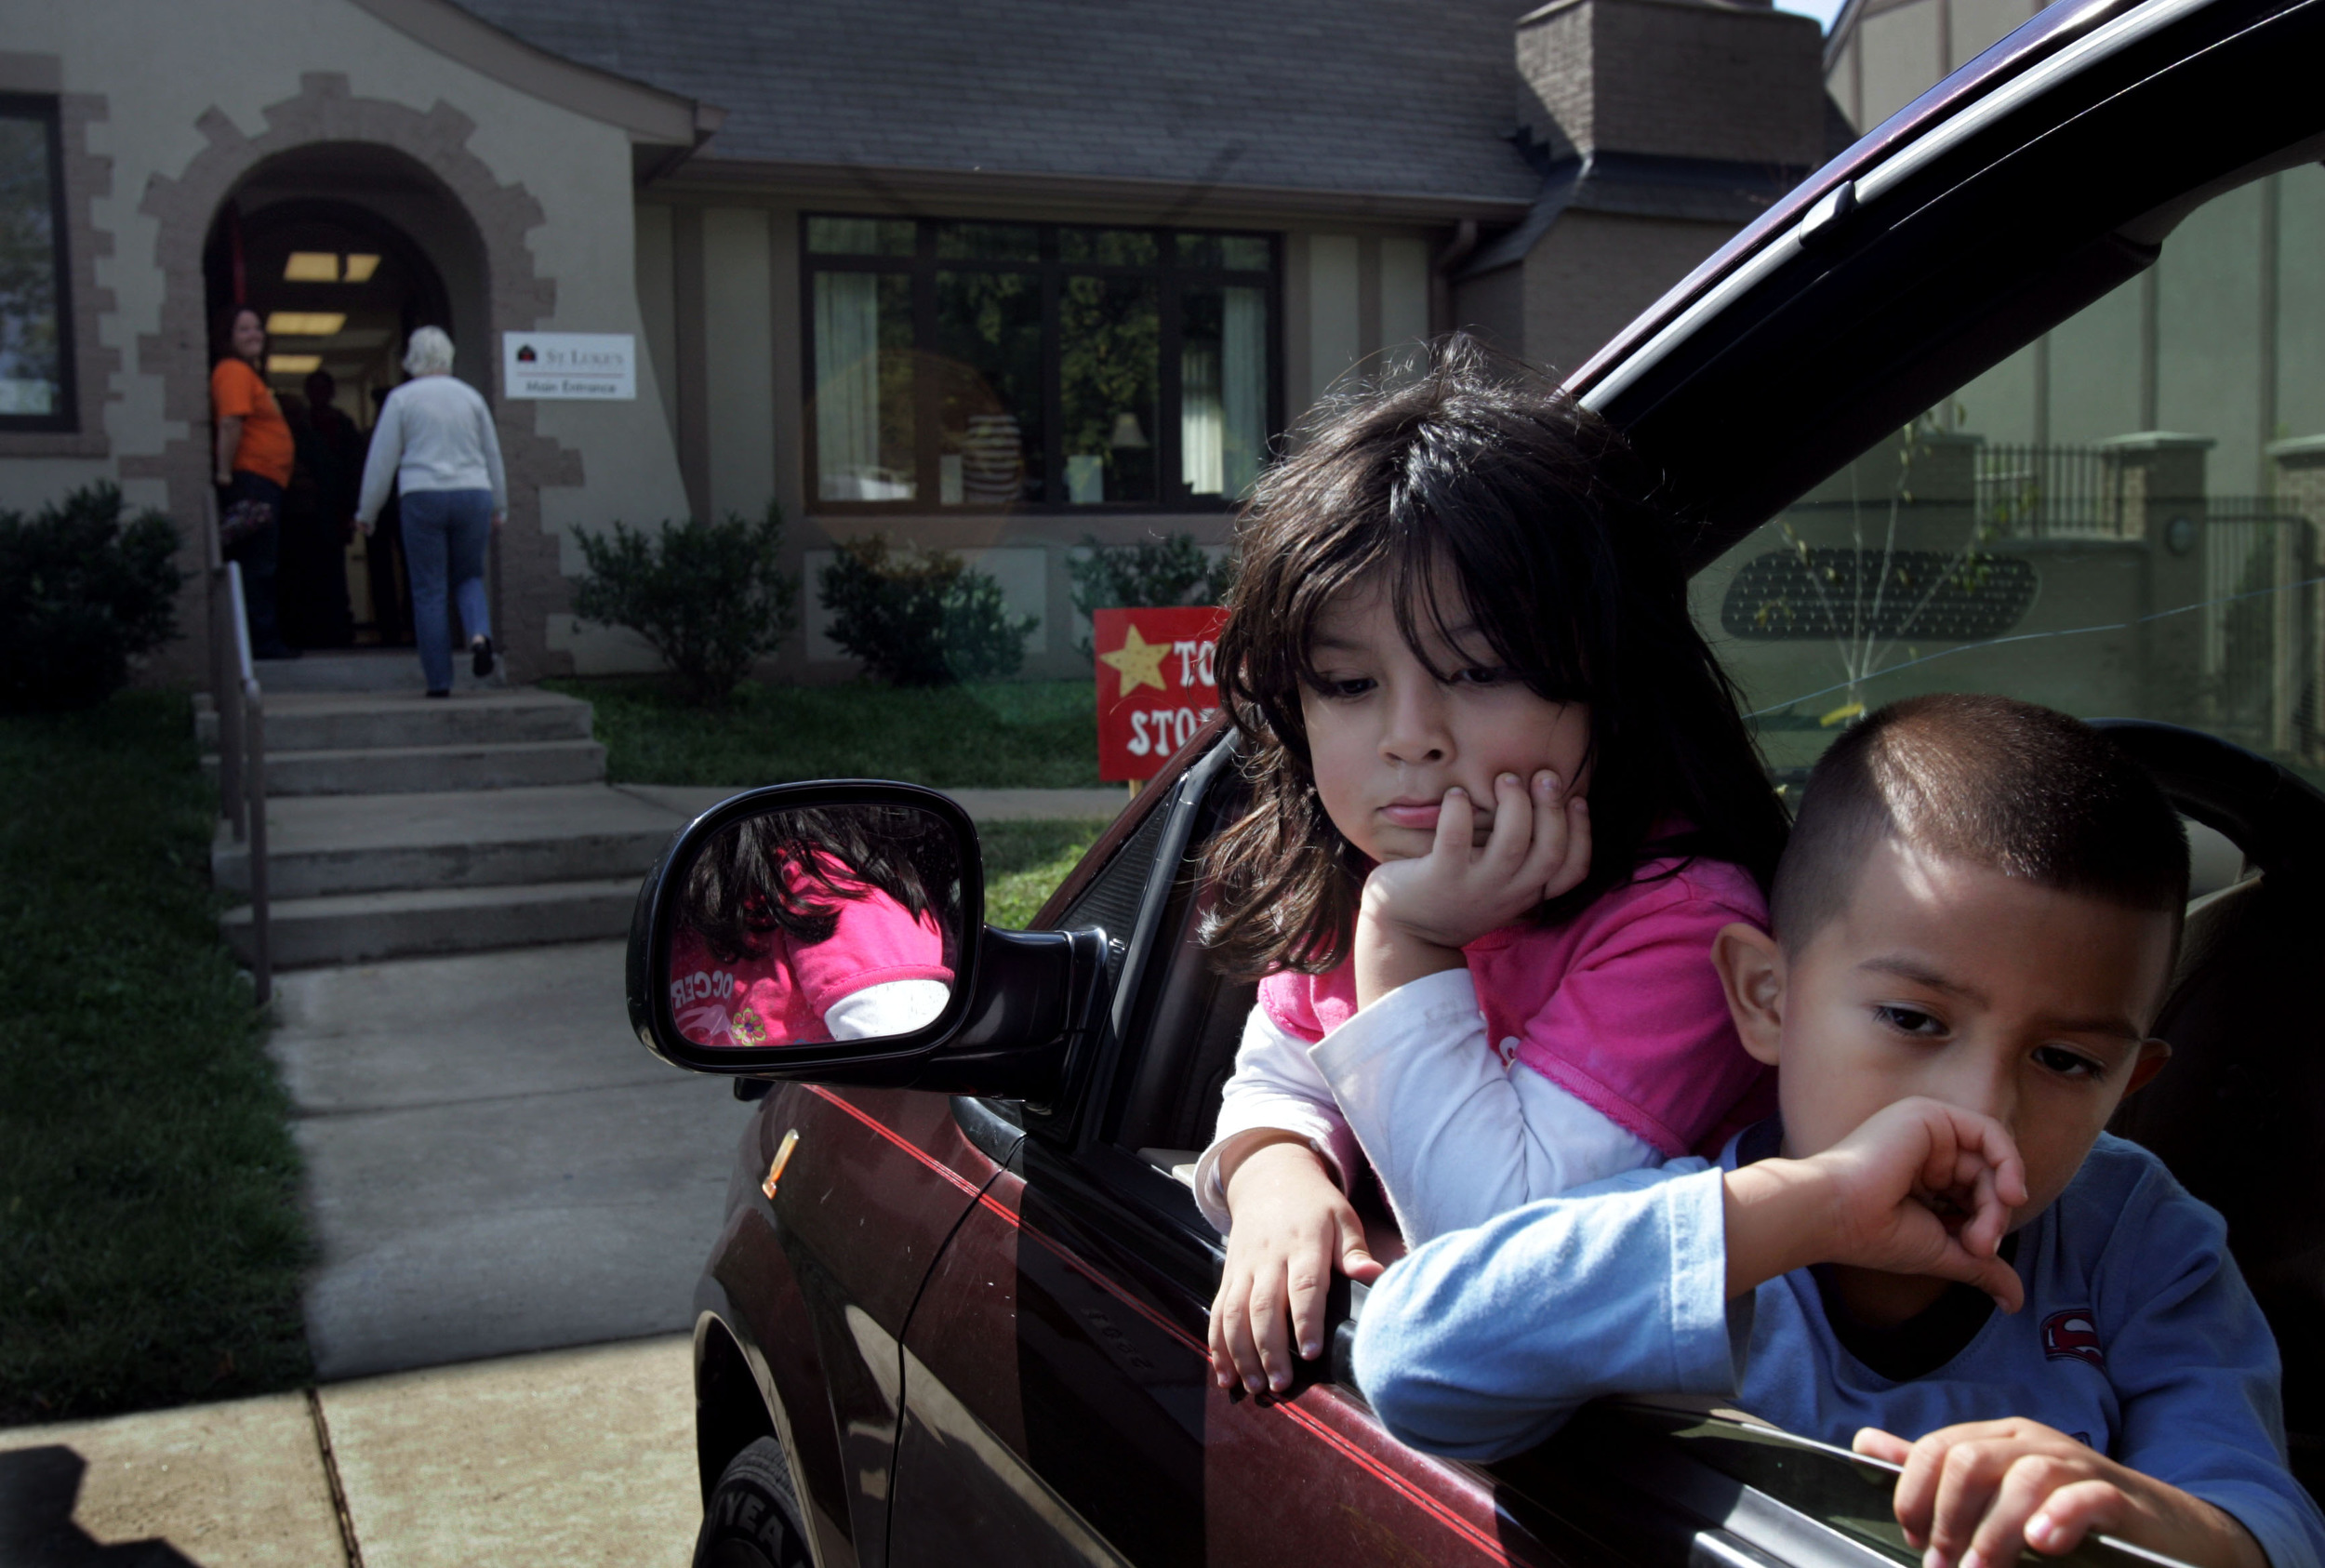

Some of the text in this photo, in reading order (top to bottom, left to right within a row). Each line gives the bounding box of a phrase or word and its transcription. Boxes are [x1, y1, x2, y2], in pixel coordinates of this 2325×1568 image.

[525, 379, 617, 393] Main Entrance
[1126, 707, 1216, 756] STO
[725, 1490, 805, 1568] YEA
